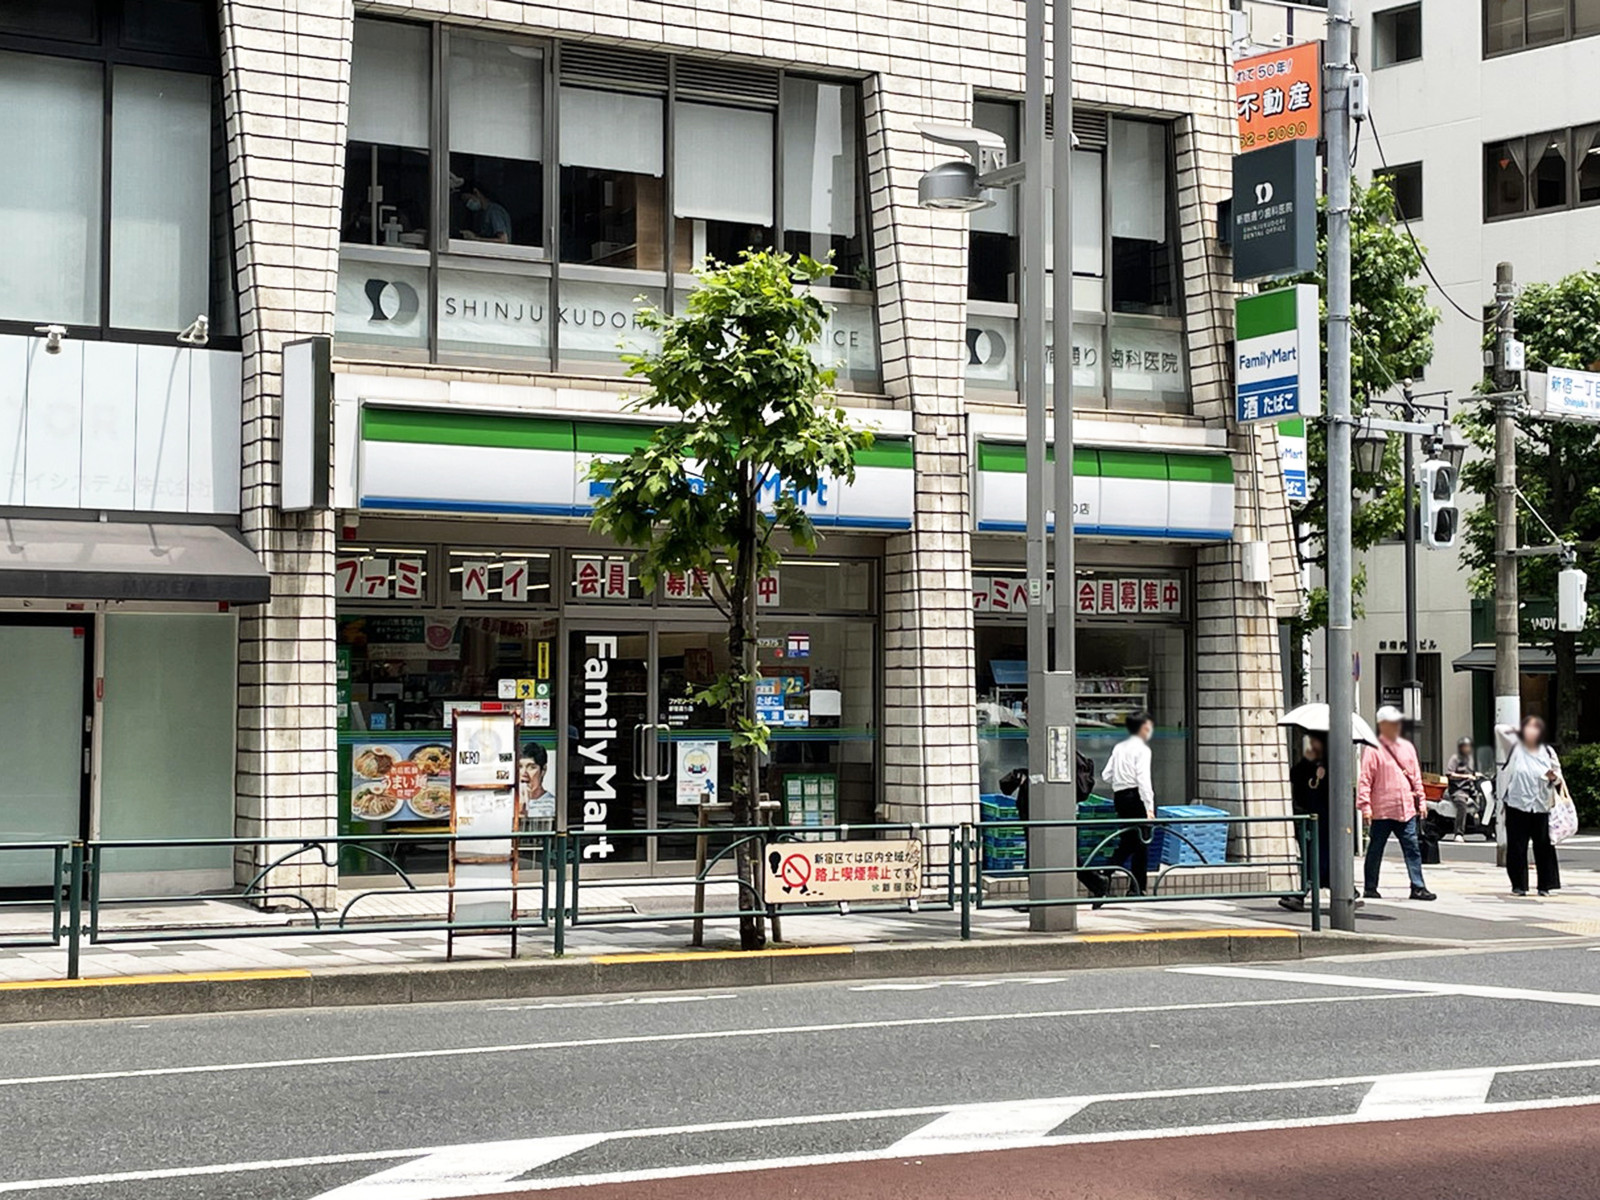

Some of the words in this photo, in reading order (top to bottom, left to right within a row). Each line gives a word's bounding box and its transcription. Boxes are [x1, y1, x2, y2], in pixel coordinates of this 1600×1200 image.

[1237, 80, 1312, 121] 不動産
[1239, 347, 1297, 370] FamilyMart
[1243, 395, 1259, 419] 酒
[1263, 393, 1294, 415] たばこ
[1079, 581, 1179, 611] 会員募集中
[756, 696, 780, 706] たばこ
[577, 636, 618, 859] FamilyMart
[815, 866, 914, 882] 路上喫煙禁止です
